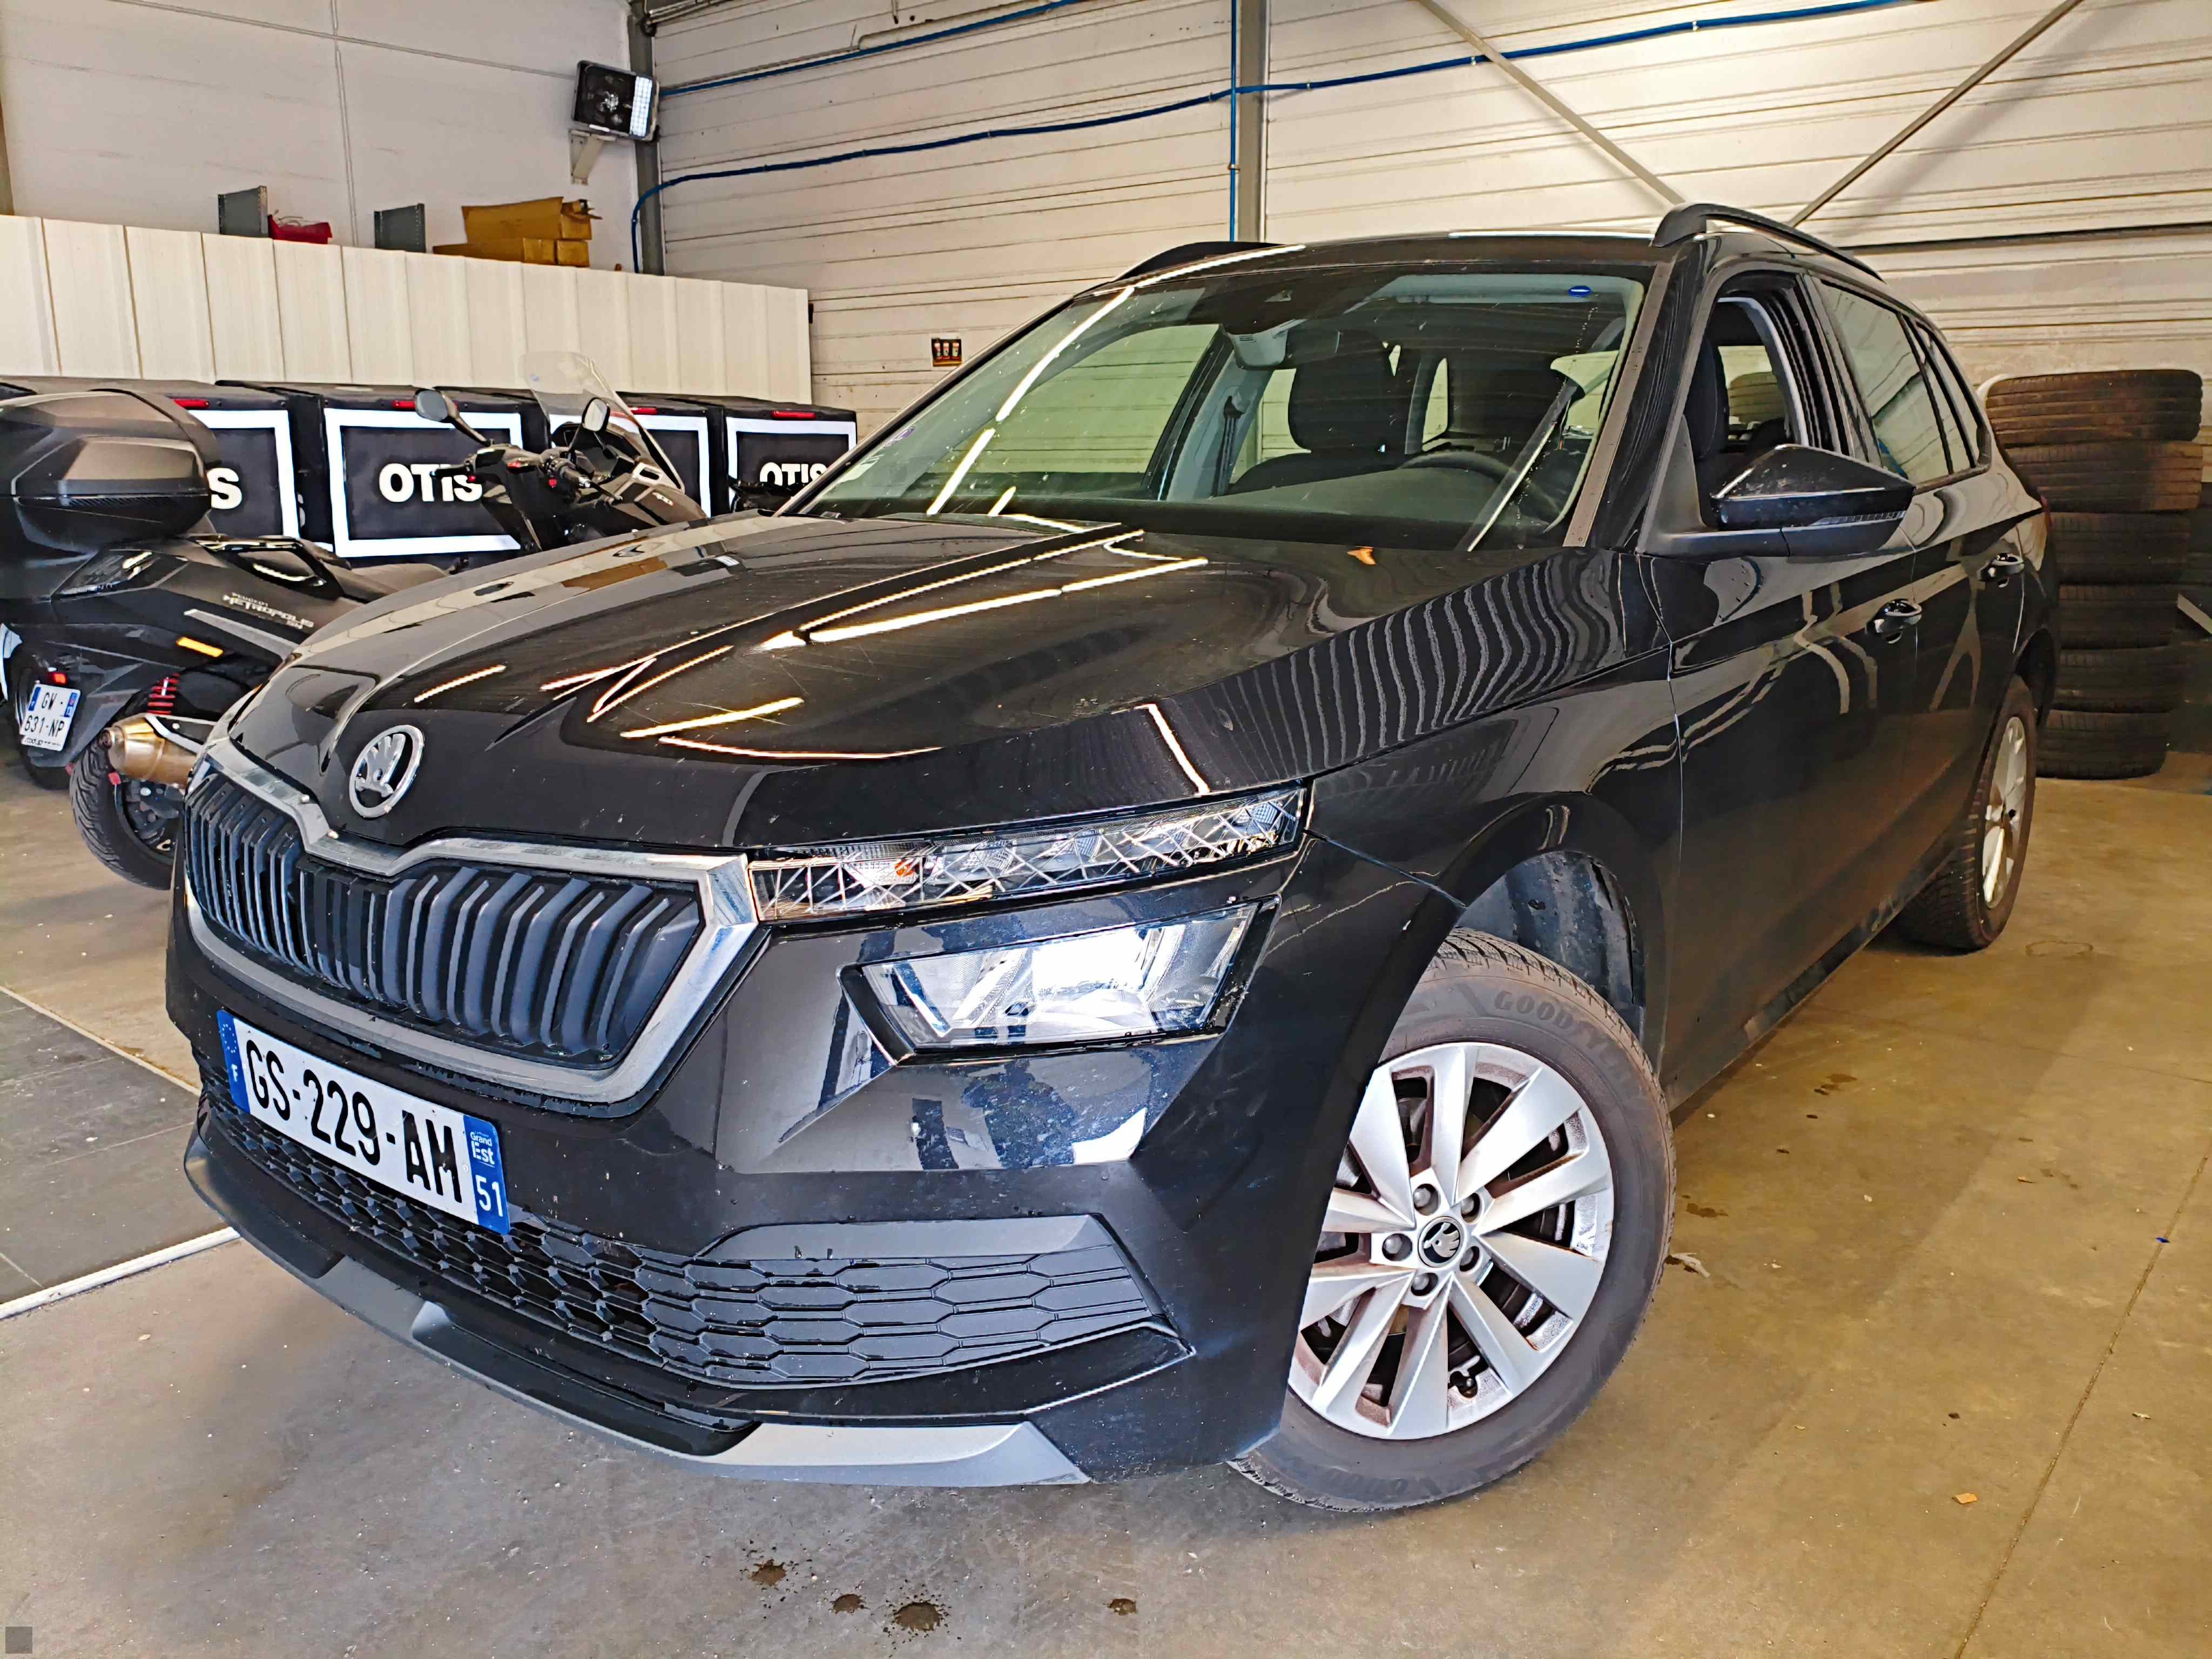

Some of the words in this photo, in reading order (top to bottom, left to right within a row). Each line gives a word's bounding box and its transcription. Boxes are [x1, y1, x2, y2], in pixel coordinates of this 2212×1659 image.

[379, 463, 483, 503] OTIS
[24, 714, 65, 738] 631-NP
[231, 1064, 239, 1082] F
[246, 1040, 463, 1203] GS-229-AM
[470, 1131, 493, 1147] Grand
[471, 1141, 495, 1165] Est
[475, 1174, 503, 1217] 51
